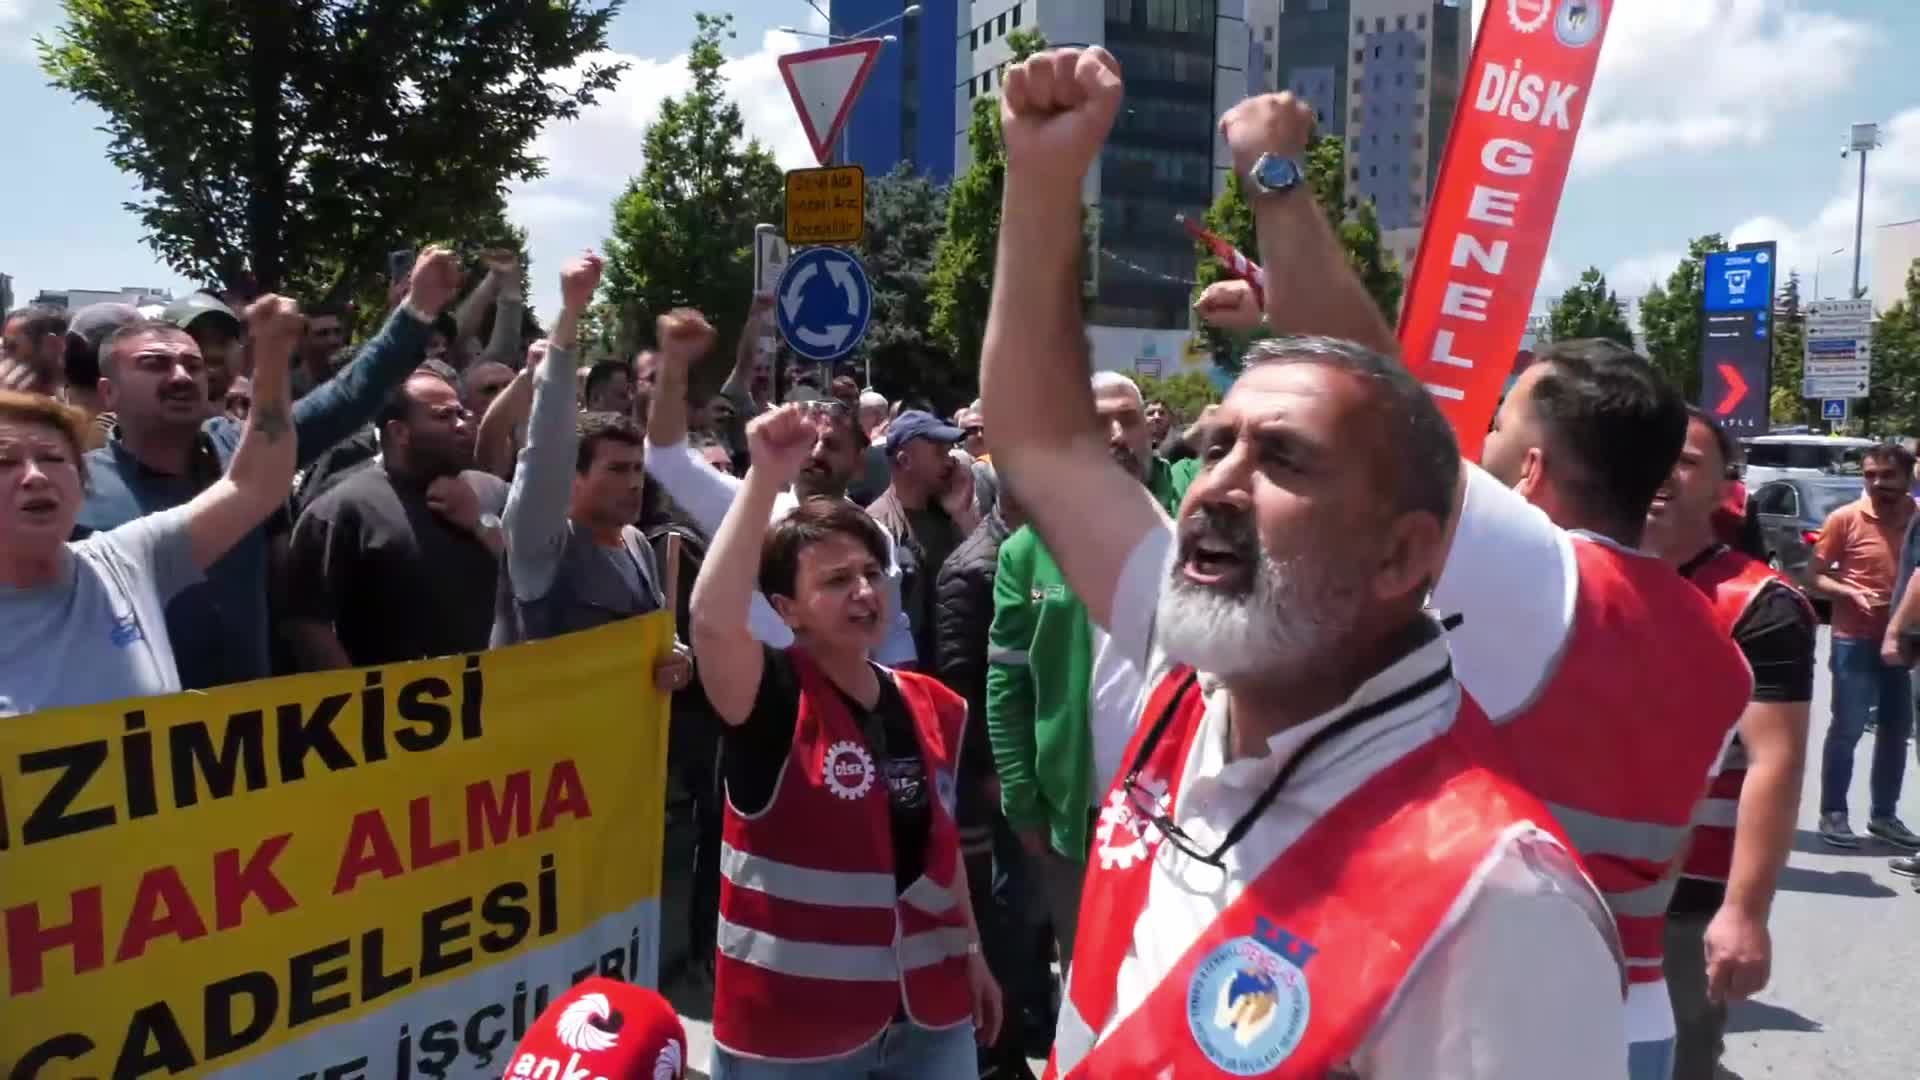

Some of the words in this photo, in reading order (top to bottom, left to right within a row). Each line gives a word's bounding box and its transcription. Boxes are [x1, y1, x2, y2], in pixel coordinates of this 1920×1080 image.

[1475, 58, 1580, 131] DİSK
[0, 655, 485, 851] ZİMKİSİ
[3, 832, 298, 997] HAK
[332, 758, 592, 896] ALMA
[514, 1050, 609, 1080] ank
